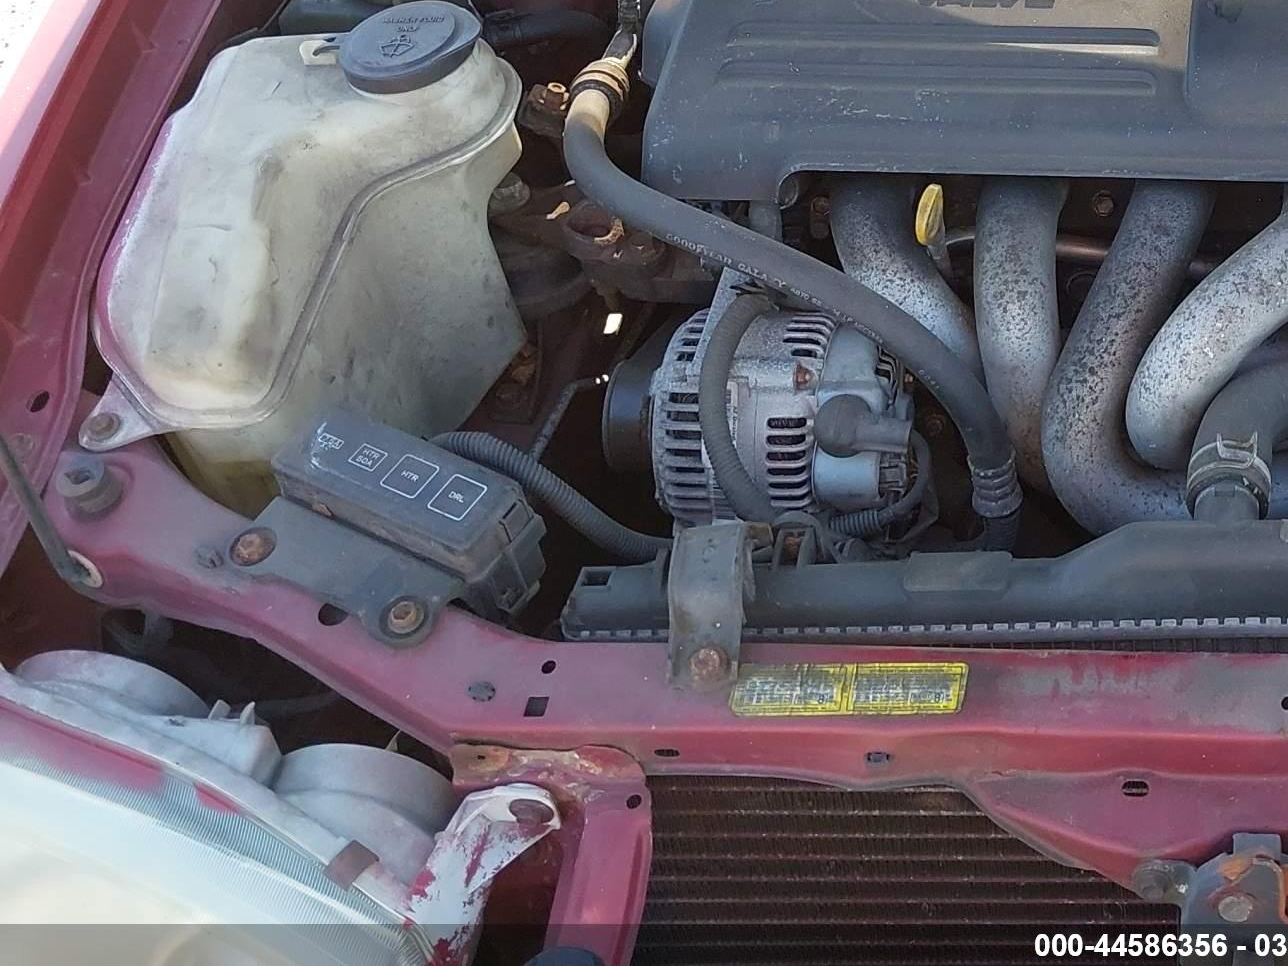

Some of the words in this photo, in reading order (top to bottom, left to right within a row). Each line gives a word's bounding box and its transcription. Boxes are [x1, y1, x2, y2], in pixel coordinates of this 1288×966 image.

[362, 448, 380, 460] HTR
[356, 456, 373, 467] 50A
[401, 470, 420, 482] HTR
[448, 490, 465, 503] DRL
